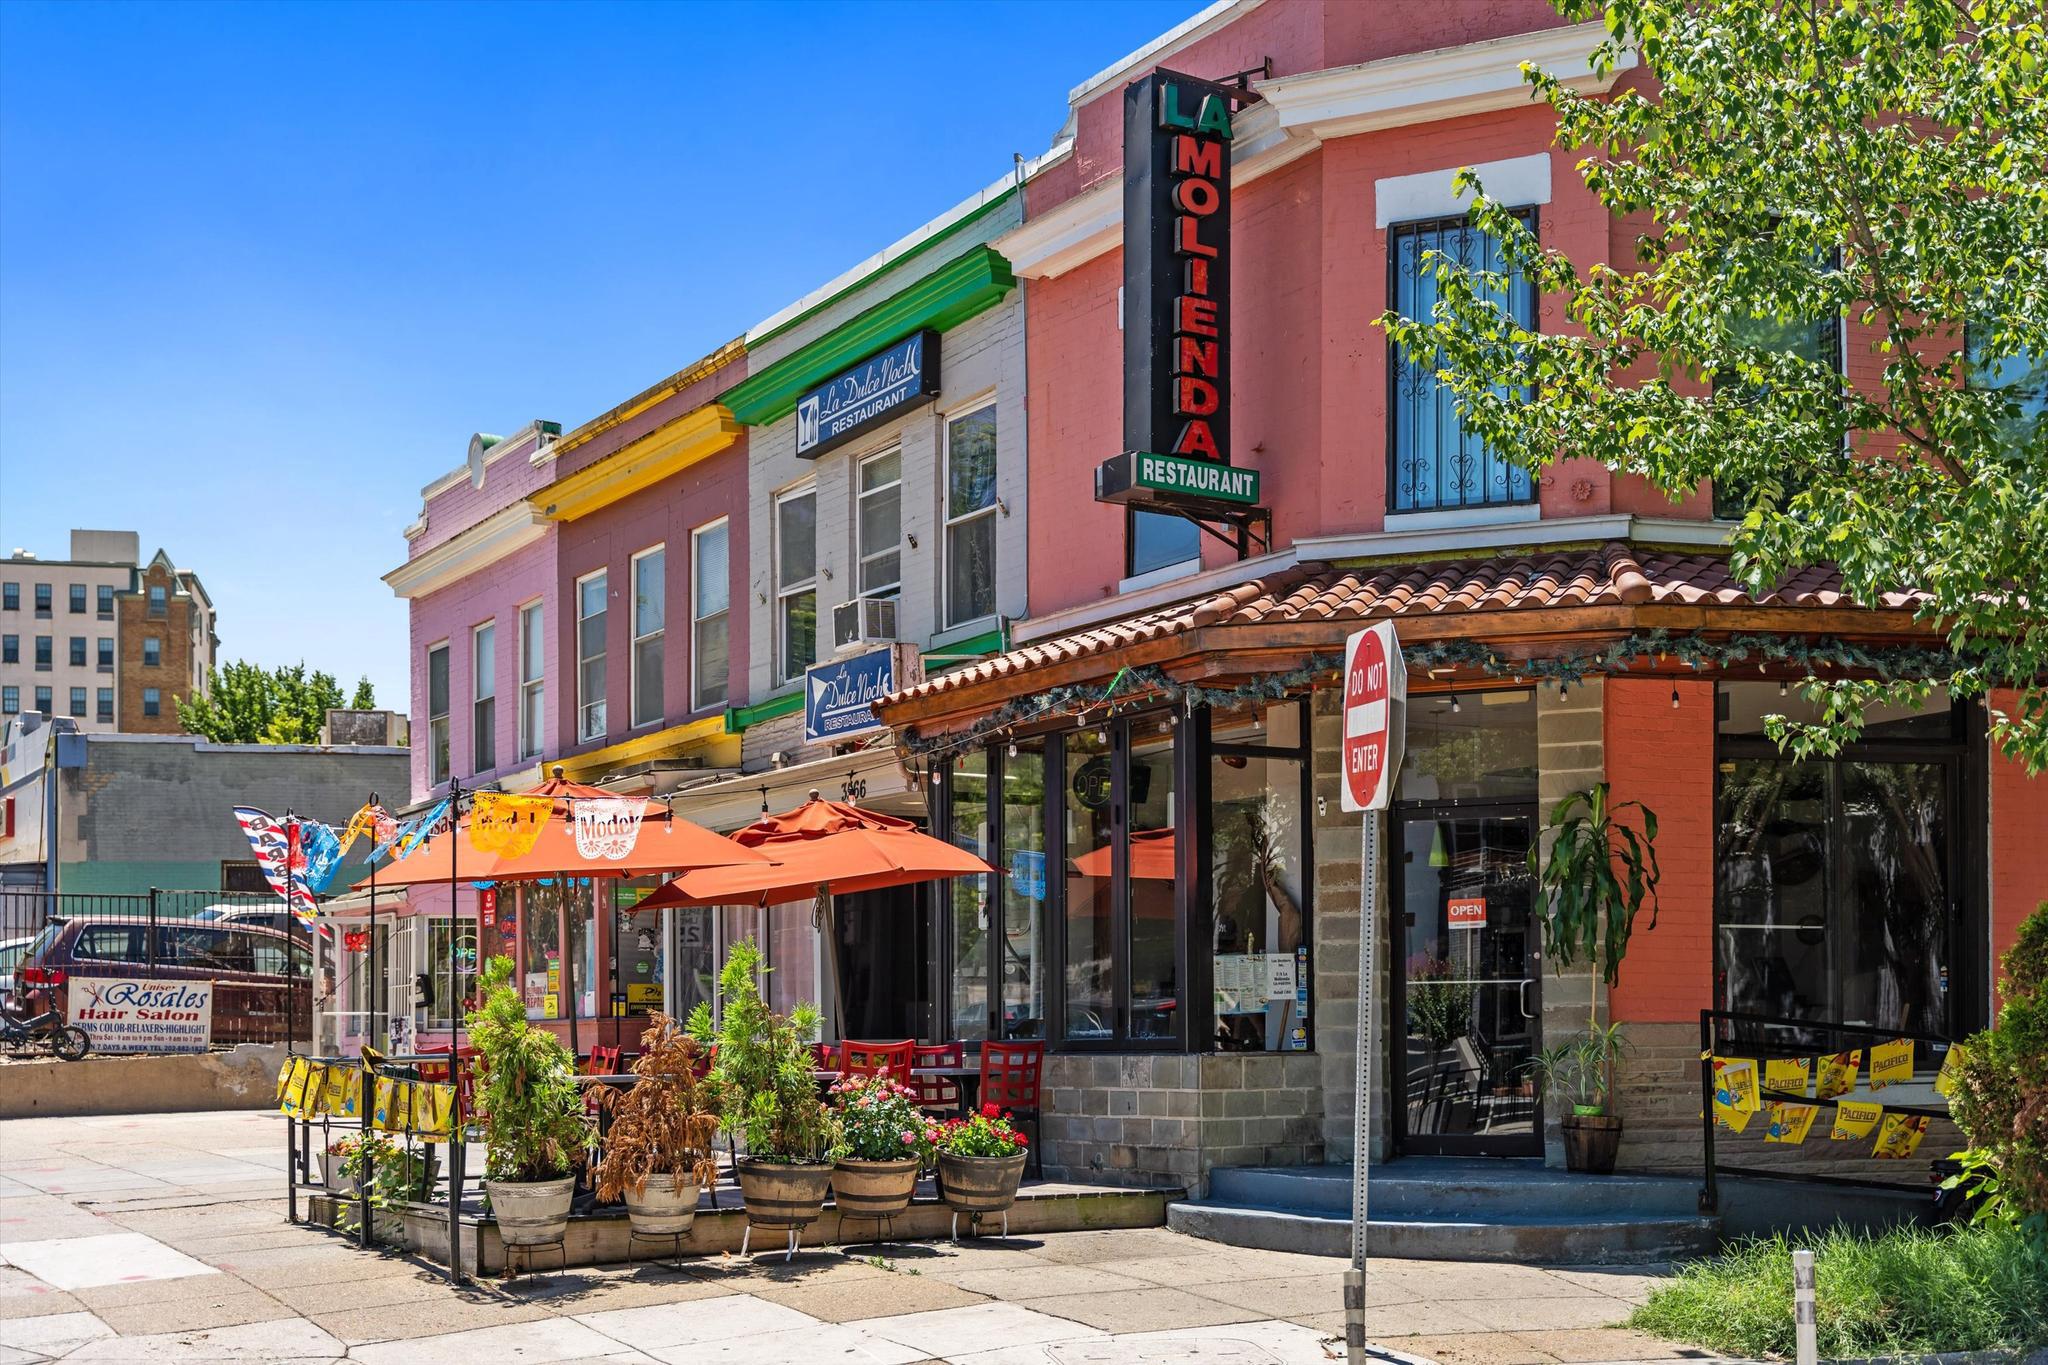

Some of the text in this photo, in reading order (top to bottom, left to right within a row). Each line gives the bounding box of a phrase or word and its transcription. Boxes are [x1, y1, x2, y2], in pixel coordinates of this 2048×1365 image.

[1160, 83, 1234, 140] LA
[1172, 135, 1222, 460] MOLIENDA
[820, 385, 840, 419] La
[842, 375, 880, 407] Dulce
[831, 386, 907, 436] RESTAURANT
[1143, 458, 1254, 497] RESTAURANT
[836, 663, 847, 681] La
[1352, 662, 1384, 697] DO NOT
[825, 675, 857, 710] Dulce
[824, 709, 880, 732] RESTAURA
[1352, 744, 1378, 774] ENTER
[249, 816, 306, 909] BARBER
[1450, 904, 1482, 916] OPEN
[449, 944, 476, 960] OPE
[105, 983, 208, 1009] Rosales
[79, 1008, 199, 1021] Hair Salon
[1873, 1053, 1909, 1073] PACIFICO
[1768, 1077, 1804, 1091] PACIFICO
[1840, 1107, 1877, 1122] PACIFICO
